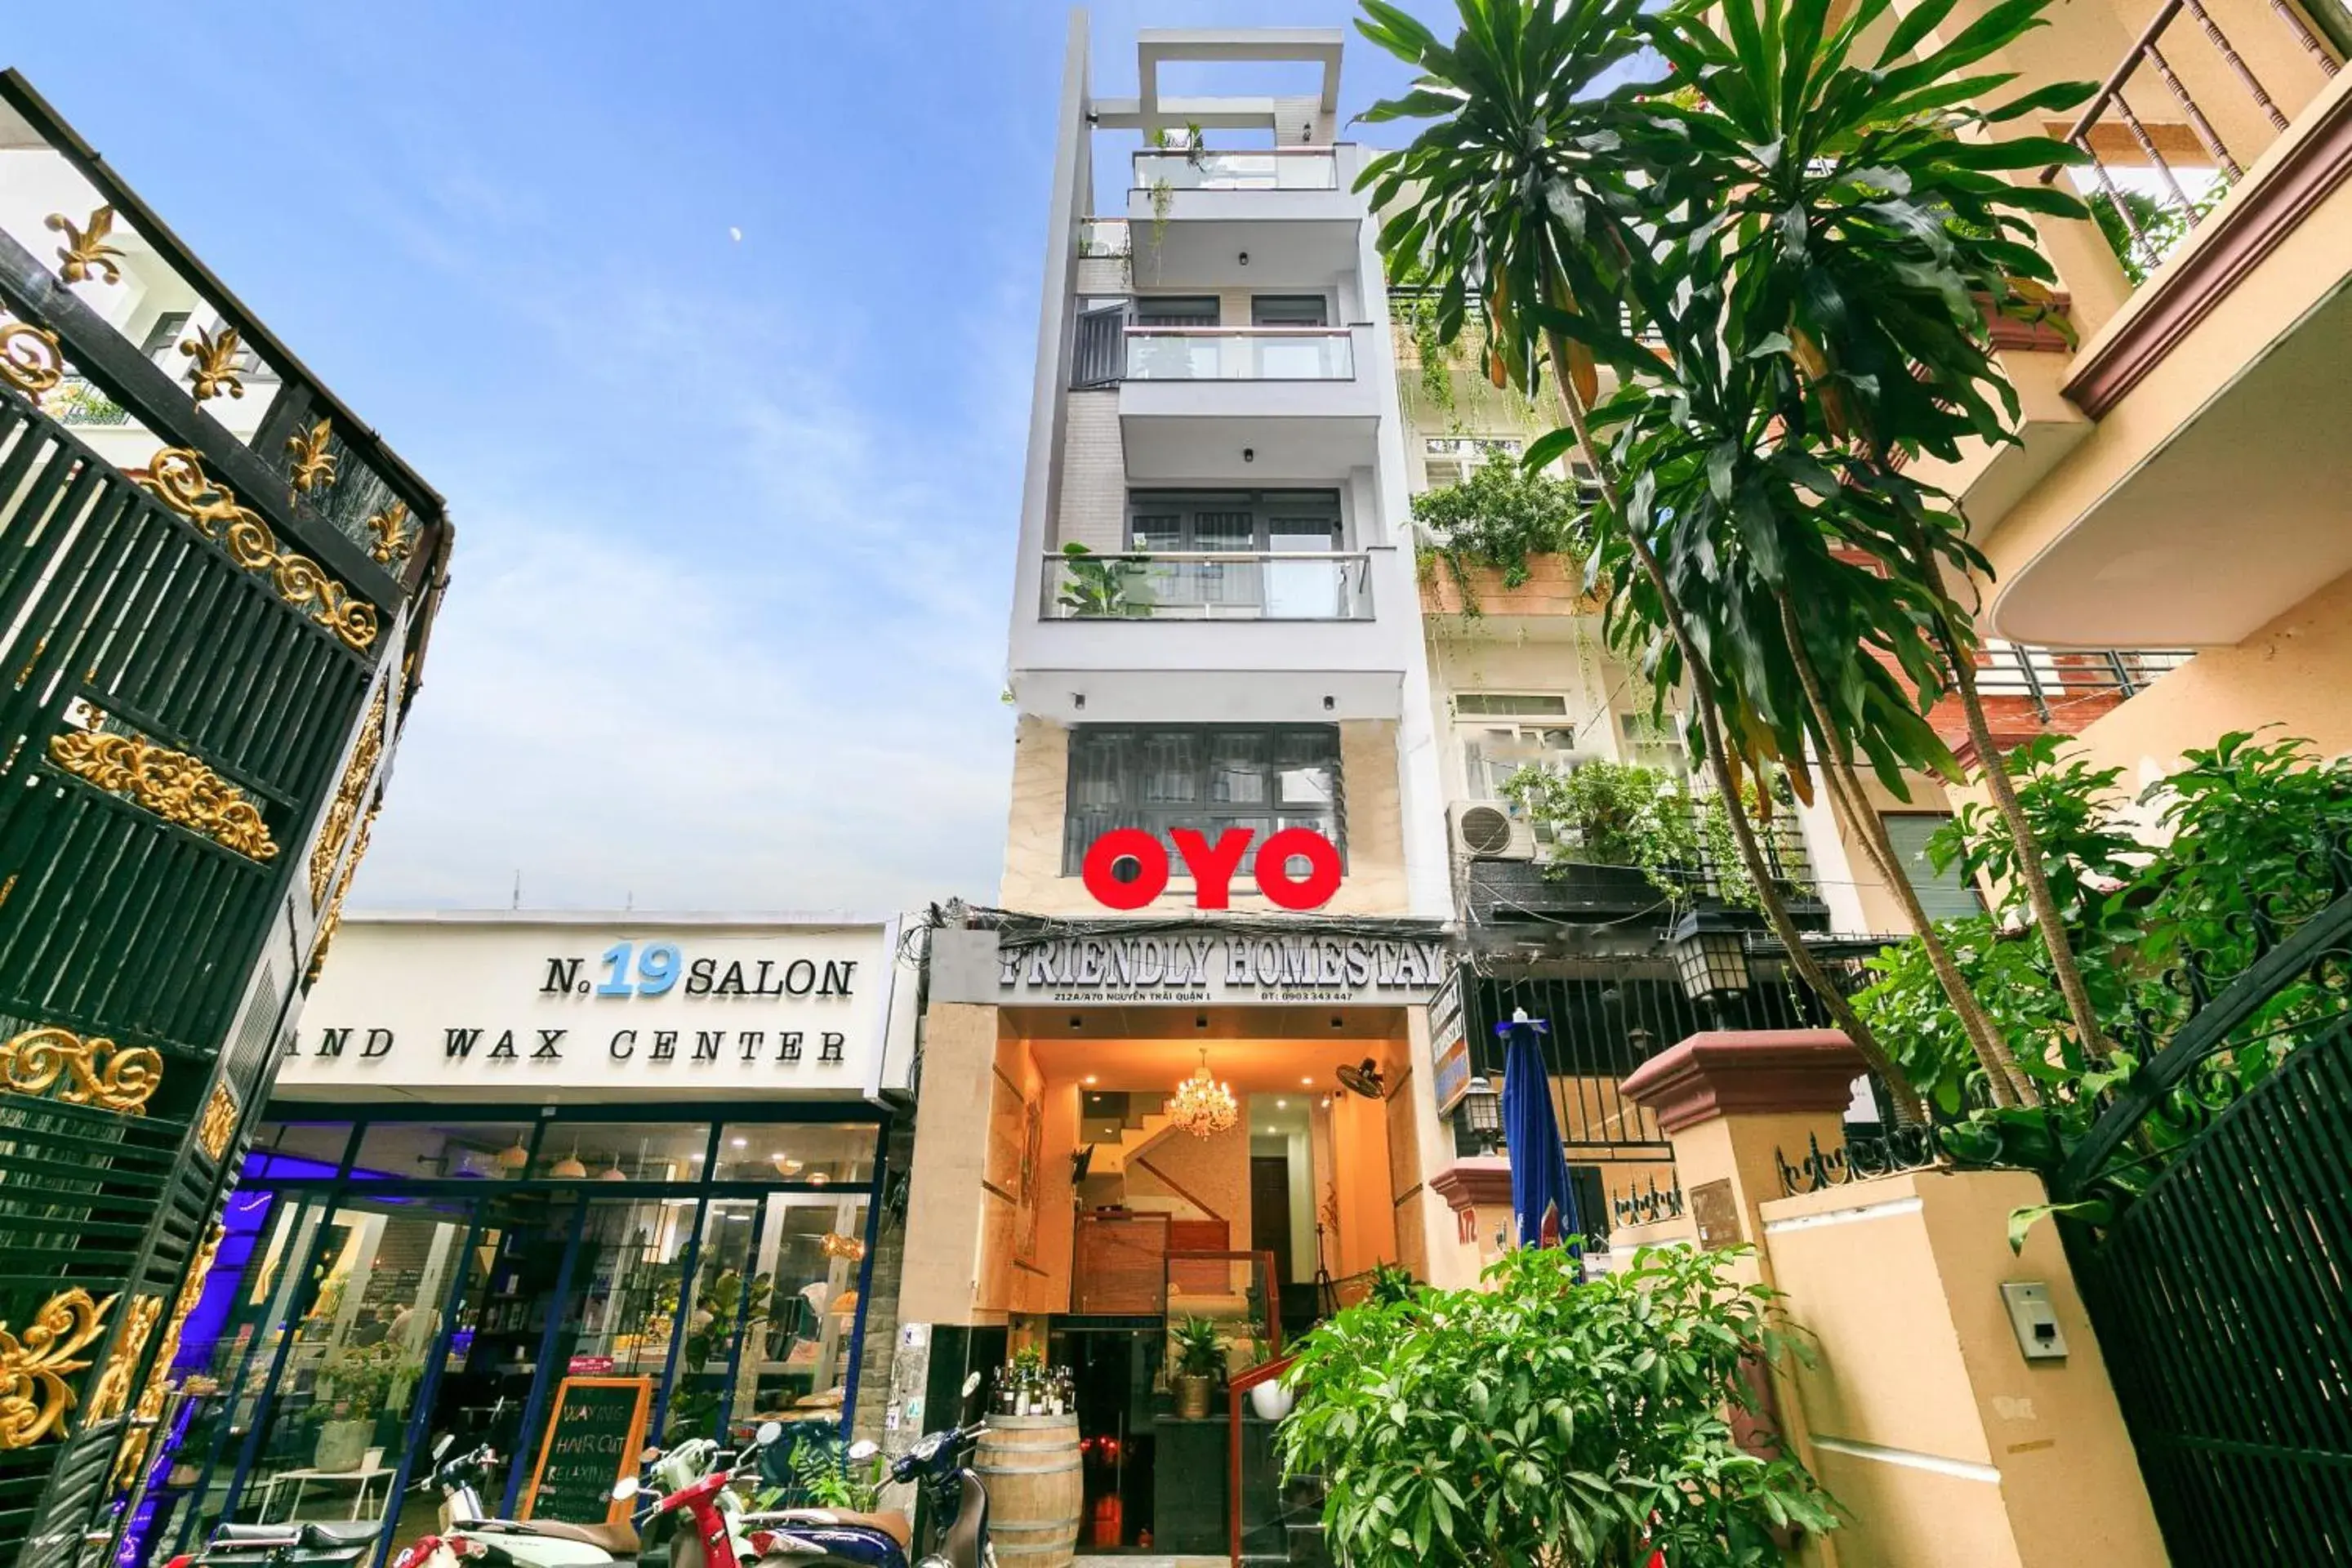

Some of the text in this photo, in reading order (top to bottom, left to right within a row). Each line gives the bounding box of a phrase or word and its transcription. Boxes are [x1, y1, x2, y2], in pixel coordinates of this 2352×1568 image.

[1081, 826, 1342, 910] OYO
[597, 942, 683, 995] 19
[685, 959, 858, 995] SALON
[1000, 936, 1444, 987] FRIENDLY HOMESTAY
[1282, 992, 1308, 1000] 0903
[1312, 991, 1330, 1000] 343
[444, 1028, 568, 1058] WAX
[610, 1029, 845, 1061] CENTER
